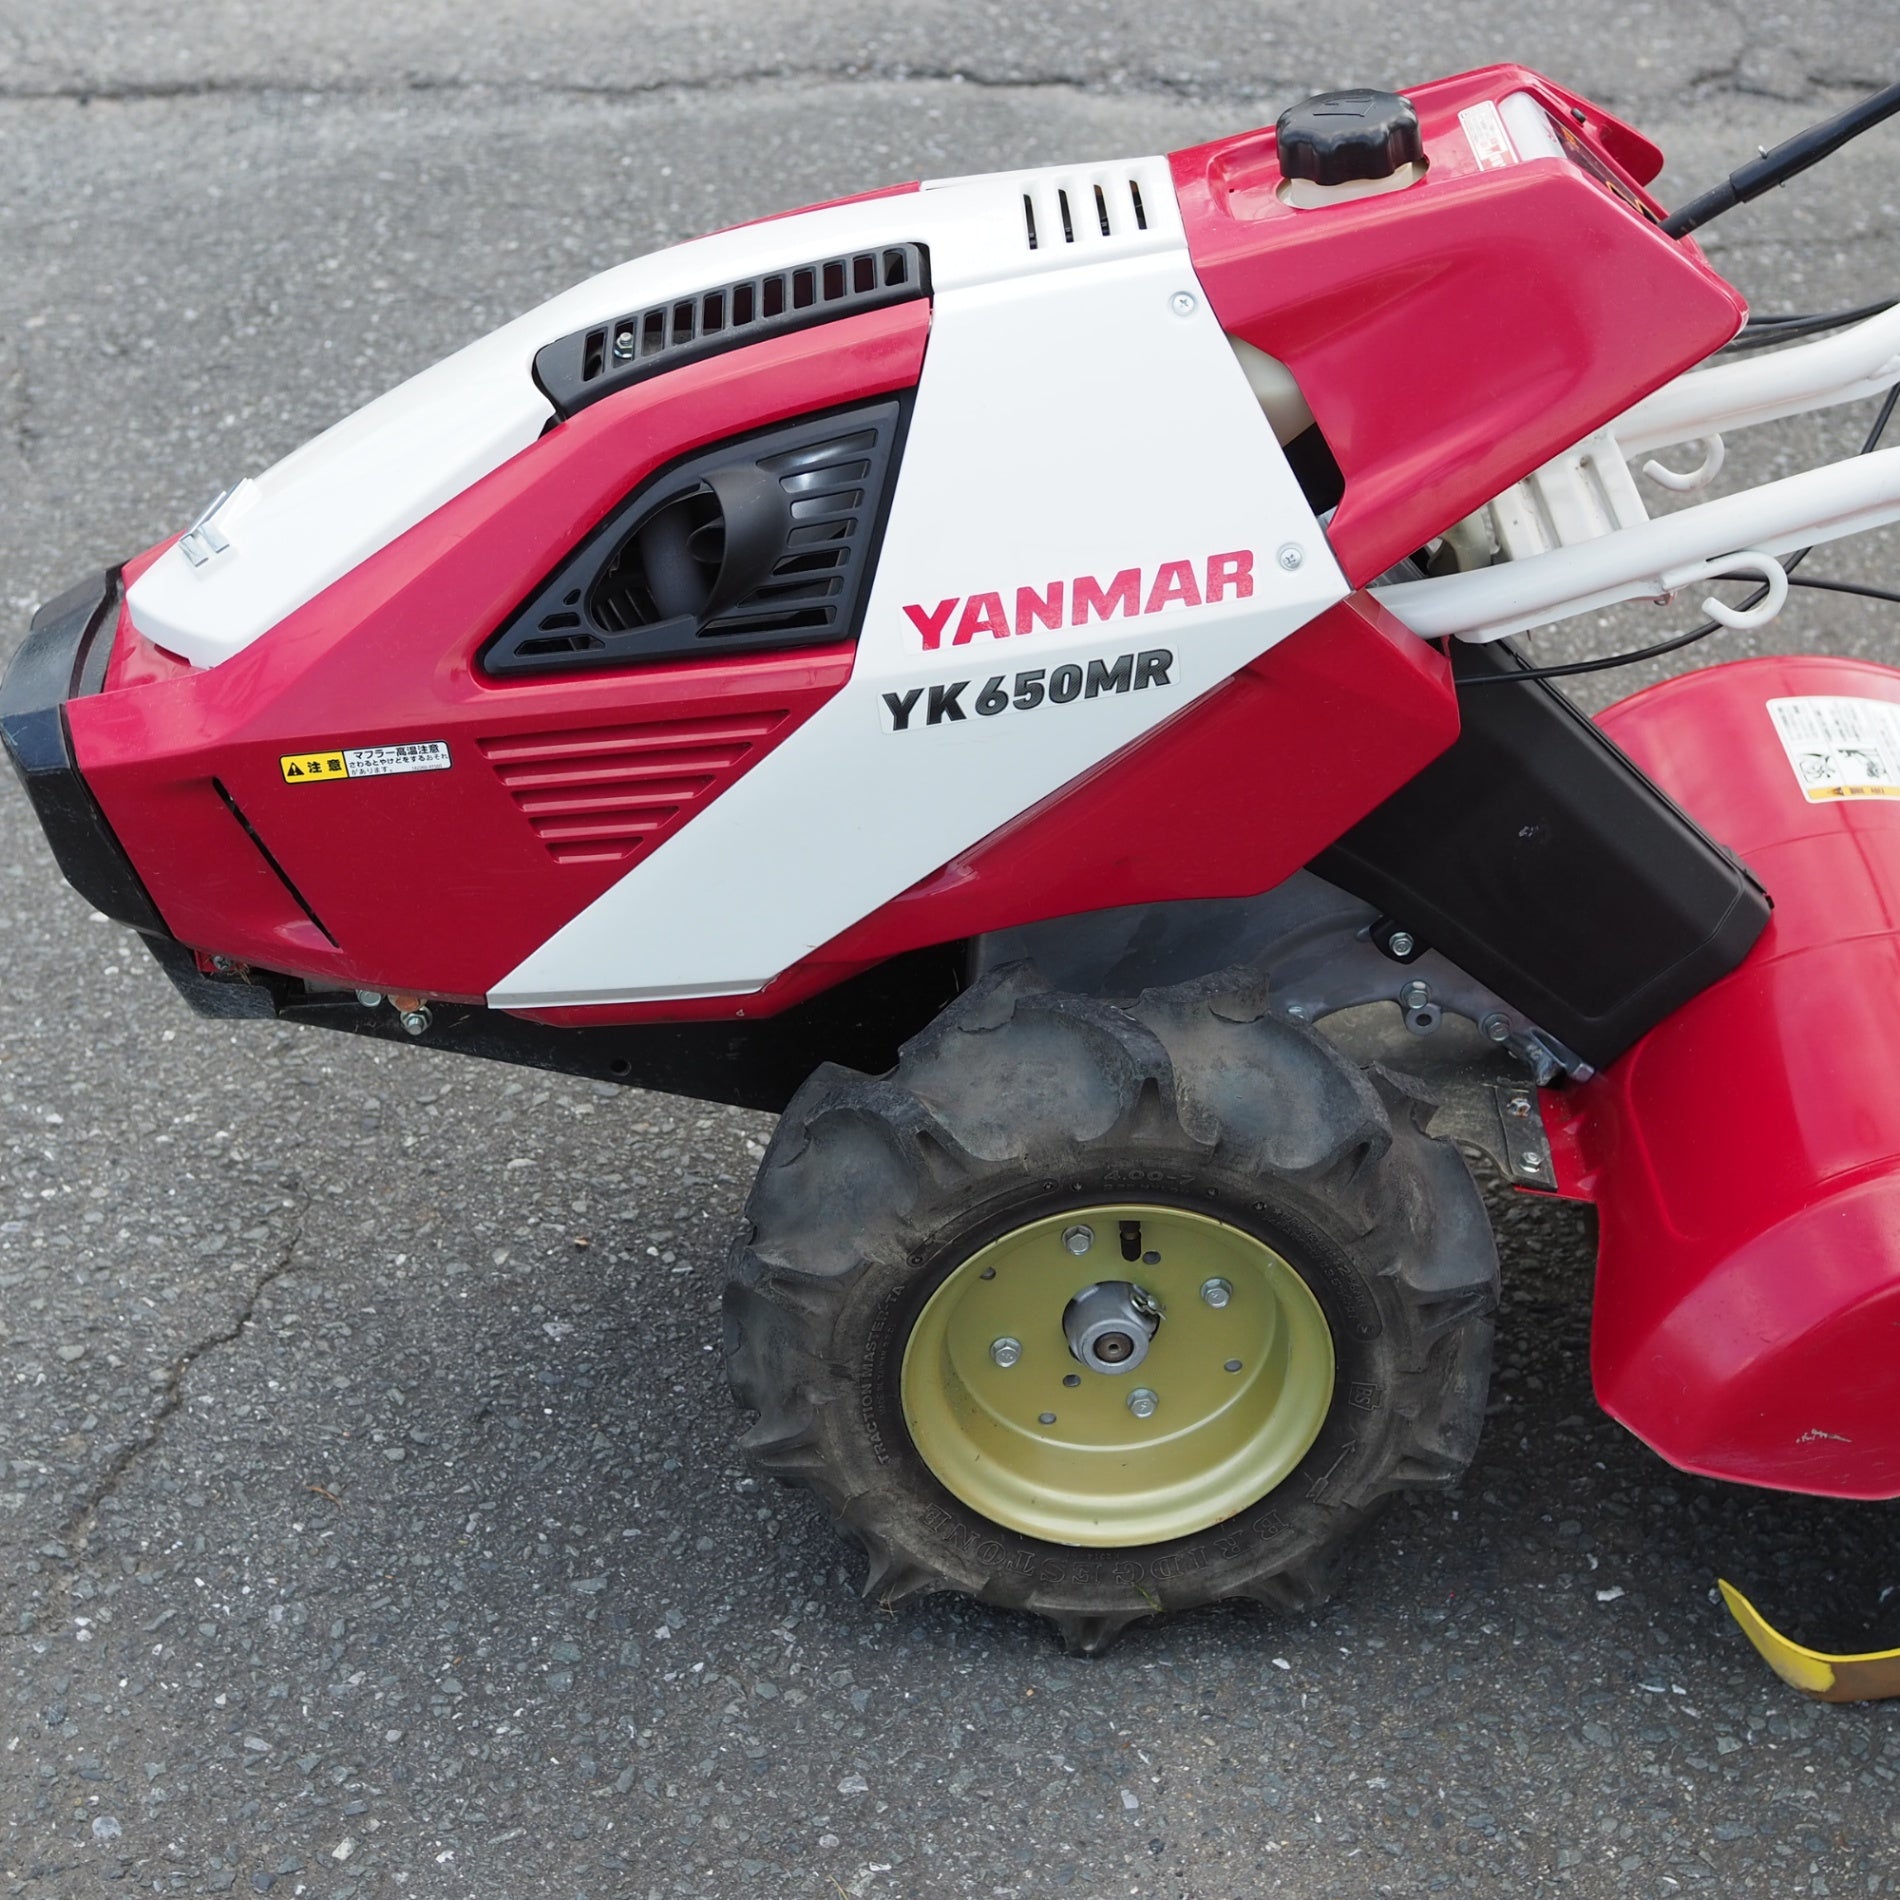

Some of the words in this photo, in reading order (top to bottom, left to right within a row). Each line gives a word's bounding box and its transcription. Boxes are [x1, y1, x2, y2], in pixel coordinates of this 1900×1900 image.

[902, 549, 1254, 652] YANMAR
[349, 753, 448, 768] さわるとやけどをするおそれ
[353, 744, 439, 760] マフラー高温注意
[1103, 1169, 1196, 1185] 4.00-7
[861, 1383, 891, 1465] TRACTION
[918, 1502, 1296, 1587] BRIDGESTONE
